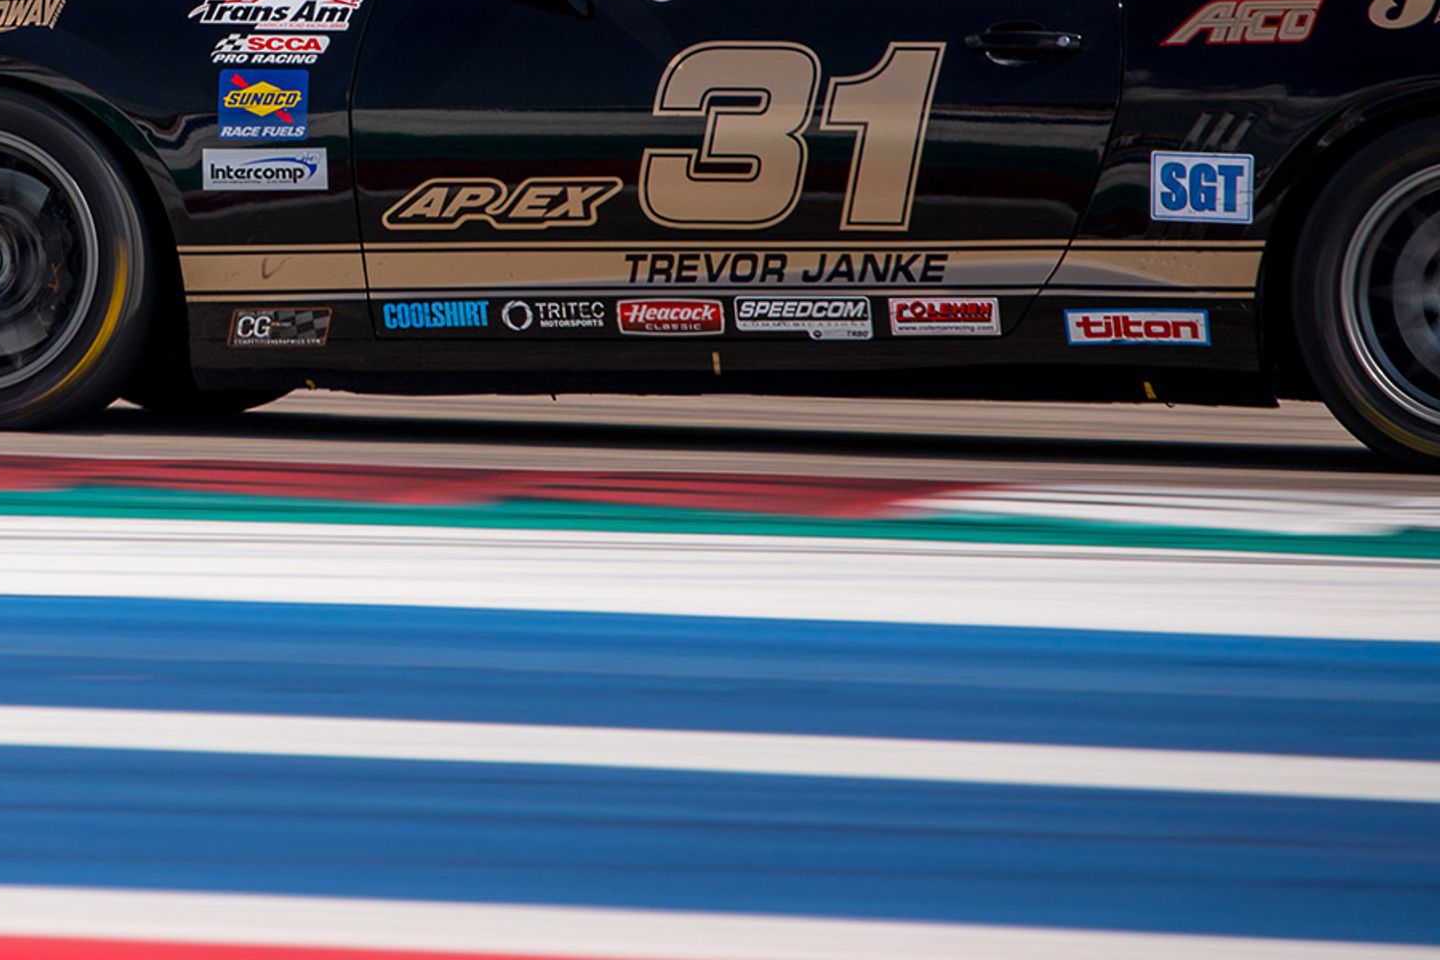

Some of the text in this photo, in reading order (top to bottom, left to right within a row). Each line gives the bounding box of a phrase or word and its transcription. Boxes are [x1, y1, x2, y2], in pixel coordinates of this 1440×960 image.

[290, 0, 350, 23] Am
[247, 37, 321, 51] SCCA
[212, 54, 318, 64] PRO RACING
[227, 92, 298, 106] SUNOCO
[220, 126, 306, 137] RACE FUELS
[637, 40, 947, 232] 31
[210, 163, 305, 184] Intercomp
[1160, 162, 1244, 212] SGT
[624, 253, 949, 284] TREVOR JANKE
[382, 300, 490, 329] COOLSHIRT
[623, 304, 716, 324] Heacock
[738, 301, 866, 319] SPEEDCOM
[895, 301, 993, 323] COLEMAN
[236, 315, 271, 338] CG
[540, 319, 605, 328] MOTORSPORTS
[1075, 315, 1200, 340] tilton
